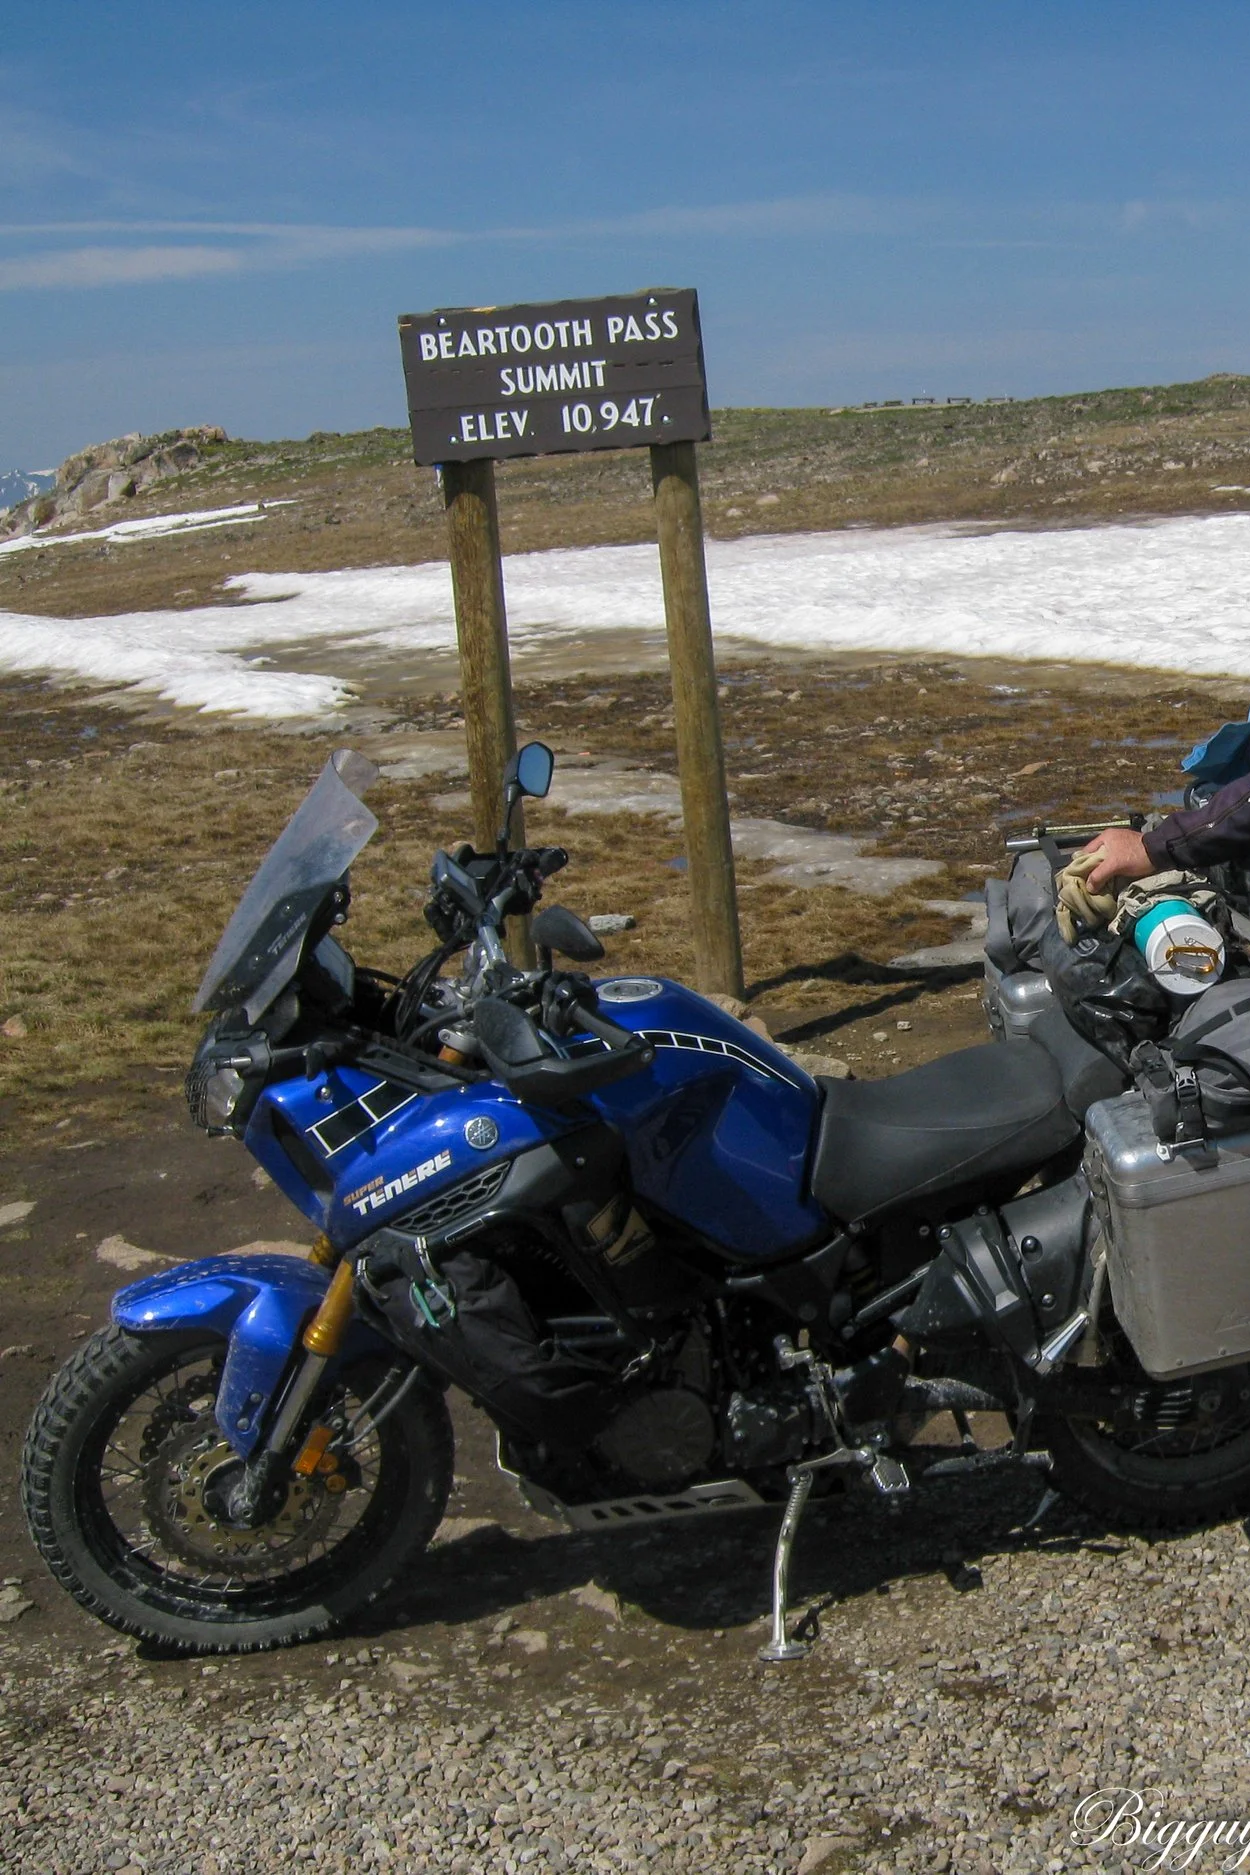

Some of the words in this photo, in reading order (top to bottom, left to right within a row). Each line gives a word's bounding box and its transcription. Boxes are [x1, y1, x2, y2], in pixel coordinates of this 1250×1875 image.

[420, 319, 593, 361] BEARTOOTH
[607, 311, 679, 344] PASS
[500, 360, 607, 396] SUMMIT
[460, 409, 536, 442] ELEV.
[343, 1175, 384, 1206] SUPER
